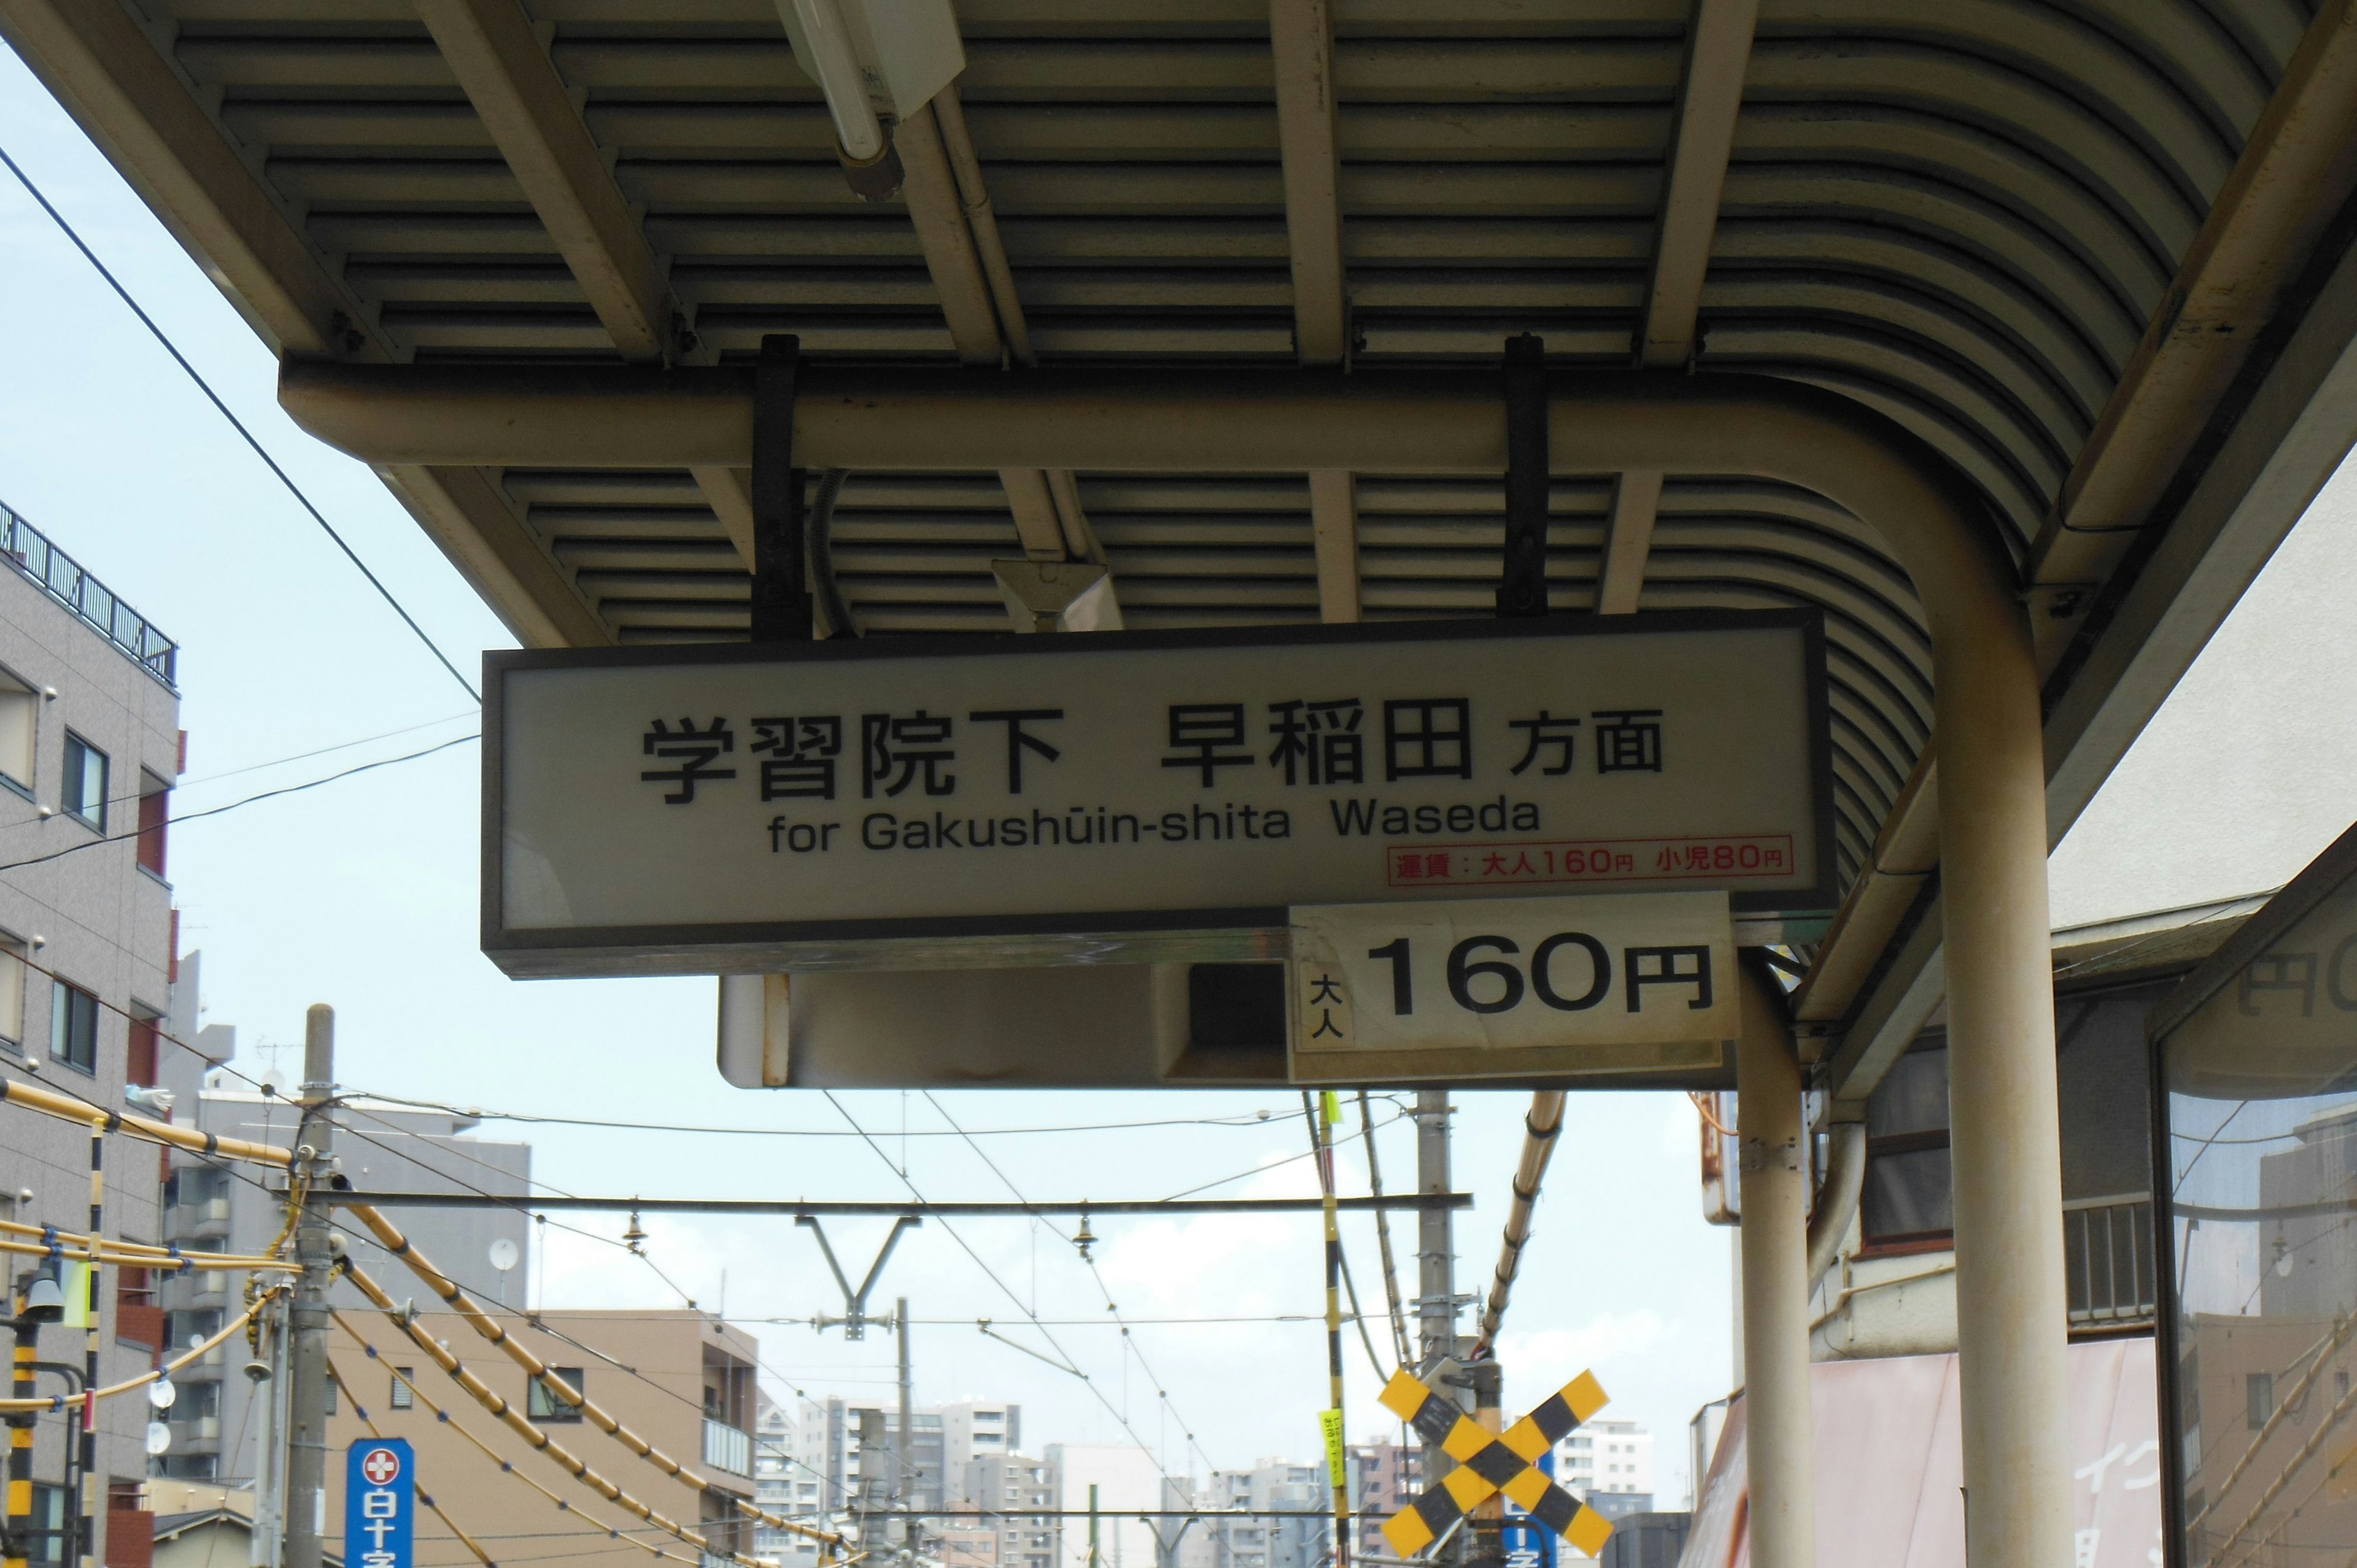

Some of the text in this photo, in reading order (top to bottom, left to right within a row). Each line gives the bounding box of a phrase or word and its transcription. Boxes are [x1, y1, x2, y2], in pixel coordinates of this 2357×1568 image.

[641, 697, 1663, 805] 学習院下 早稲田 方面
[767, 794, 1541, 853] for Gakushūin-shita Waseda
[1657, 844, 1783, 870] 小児80円
[1310, 973, 1344, 1039] 大人
[1368, 932, 1713, 1016] 160円
